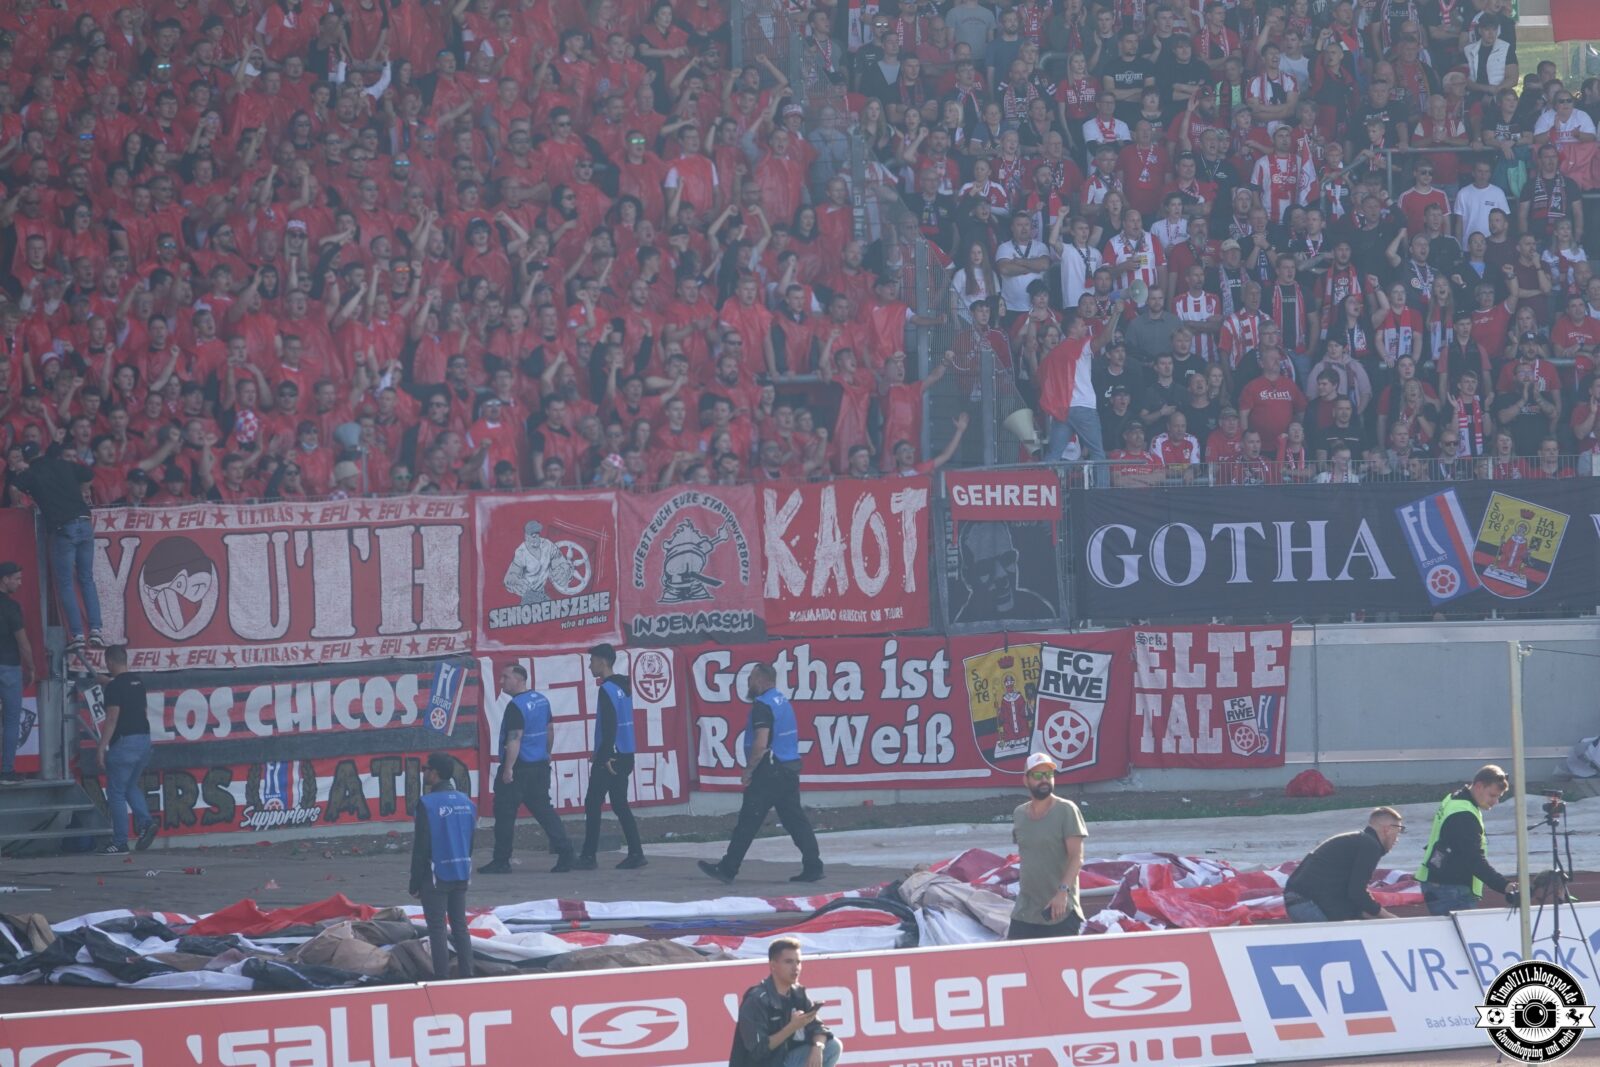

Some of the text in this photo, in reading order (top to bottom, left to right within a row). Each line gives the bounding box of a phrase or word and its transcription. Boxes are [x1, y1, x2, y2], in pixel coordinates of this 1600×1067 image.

[952, 484, 1057, 507] GEHREN
[236, 505, 294, 526] ULTRAS
[634, 531, 652, 588] SCHIEBT
[650, 505, 672, 534] EUCH
[763, 484, 928, 599] KAOT
[1086, 516, 1396, 589] GOTHA
[488, 591, 611, 629] SENIORENSZENE
[633, 611, 754, 634] IN DEN ARSCH
[241, 645, 299, 665] ULTRAS
[692, 639, 952, 703] Gotha ist
[1057, 650, 1094, 675] FC
[1134, 630, 1286, 689] ELTE
[1042, 670, 1103, 699] RWE
[146, 673, 419, 741] LOS CHICOS
[1226, 706, 1254, 720] RWE
[1230, 698, 1246, 710] FC
[696, 704, 955, 769] R-Weiß
[1135, 693, 1223, 754] TAL
[240, 804, 321, 831] Supporters
[800, 965, 1027, 1039] aller
[1426, 1017, 1446, 1029] Bad
